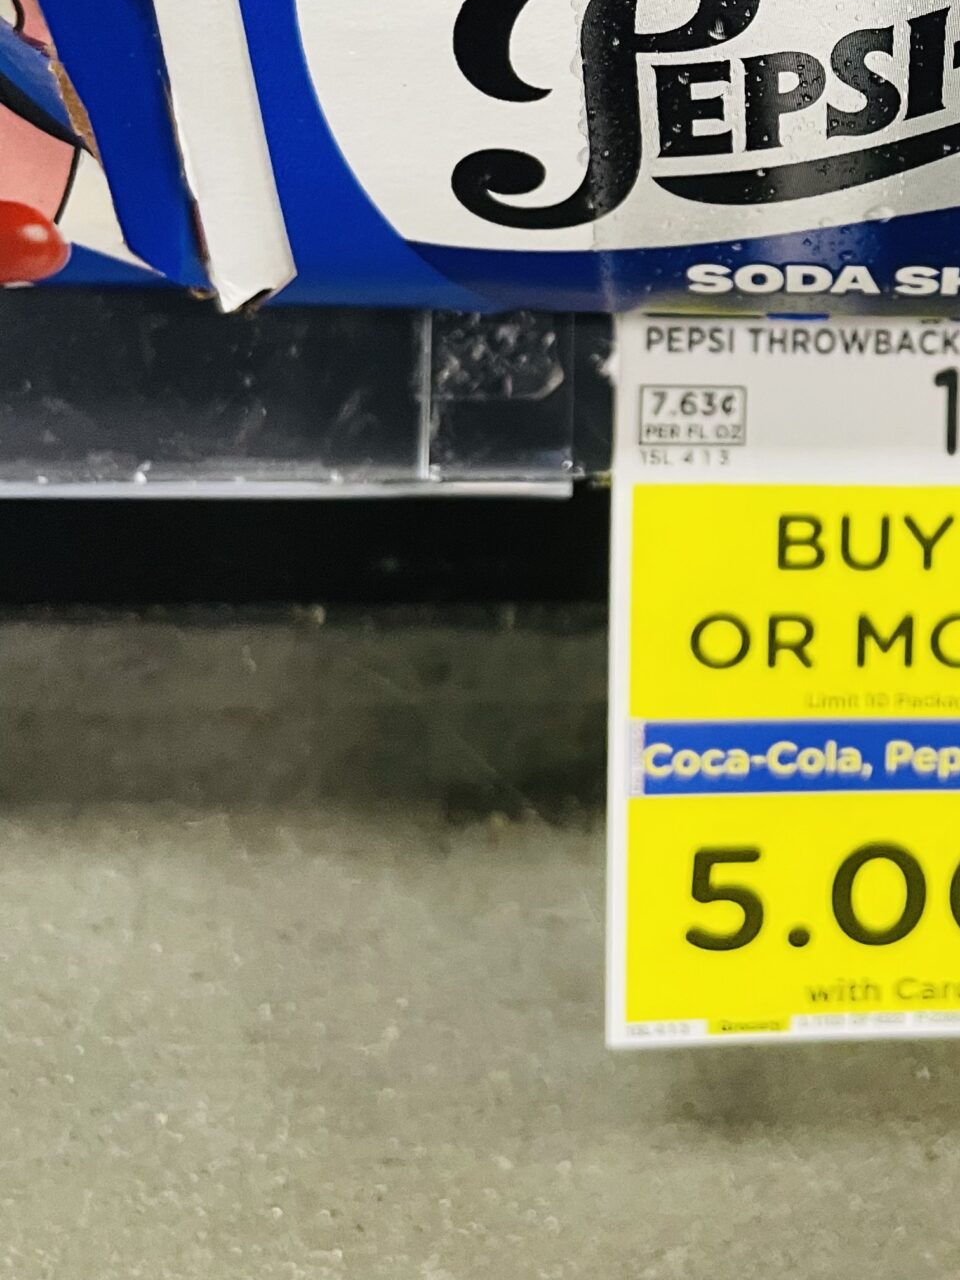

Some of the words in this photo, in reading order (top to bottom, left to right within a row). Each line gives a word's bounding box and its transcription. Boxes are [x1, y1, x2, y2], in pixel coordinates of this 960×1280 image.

[686, 263, 881, 295] SODA
[645, 325, 734, 354] PEPSI
[749, 327, 960, 356] THROWBACK
[650, 391, 736, 417] 7.63¢
[645, 423, 680, 439] PER
[686, 423, 707, 439] FL
[715, 424, 743, 439] OZ
[776, 513, 955, 572] BUY
[689, 612, 815, 669] OR
[643, 741, 873, 780] Coca-Cola,
[807, 978, 882, 1005] with
